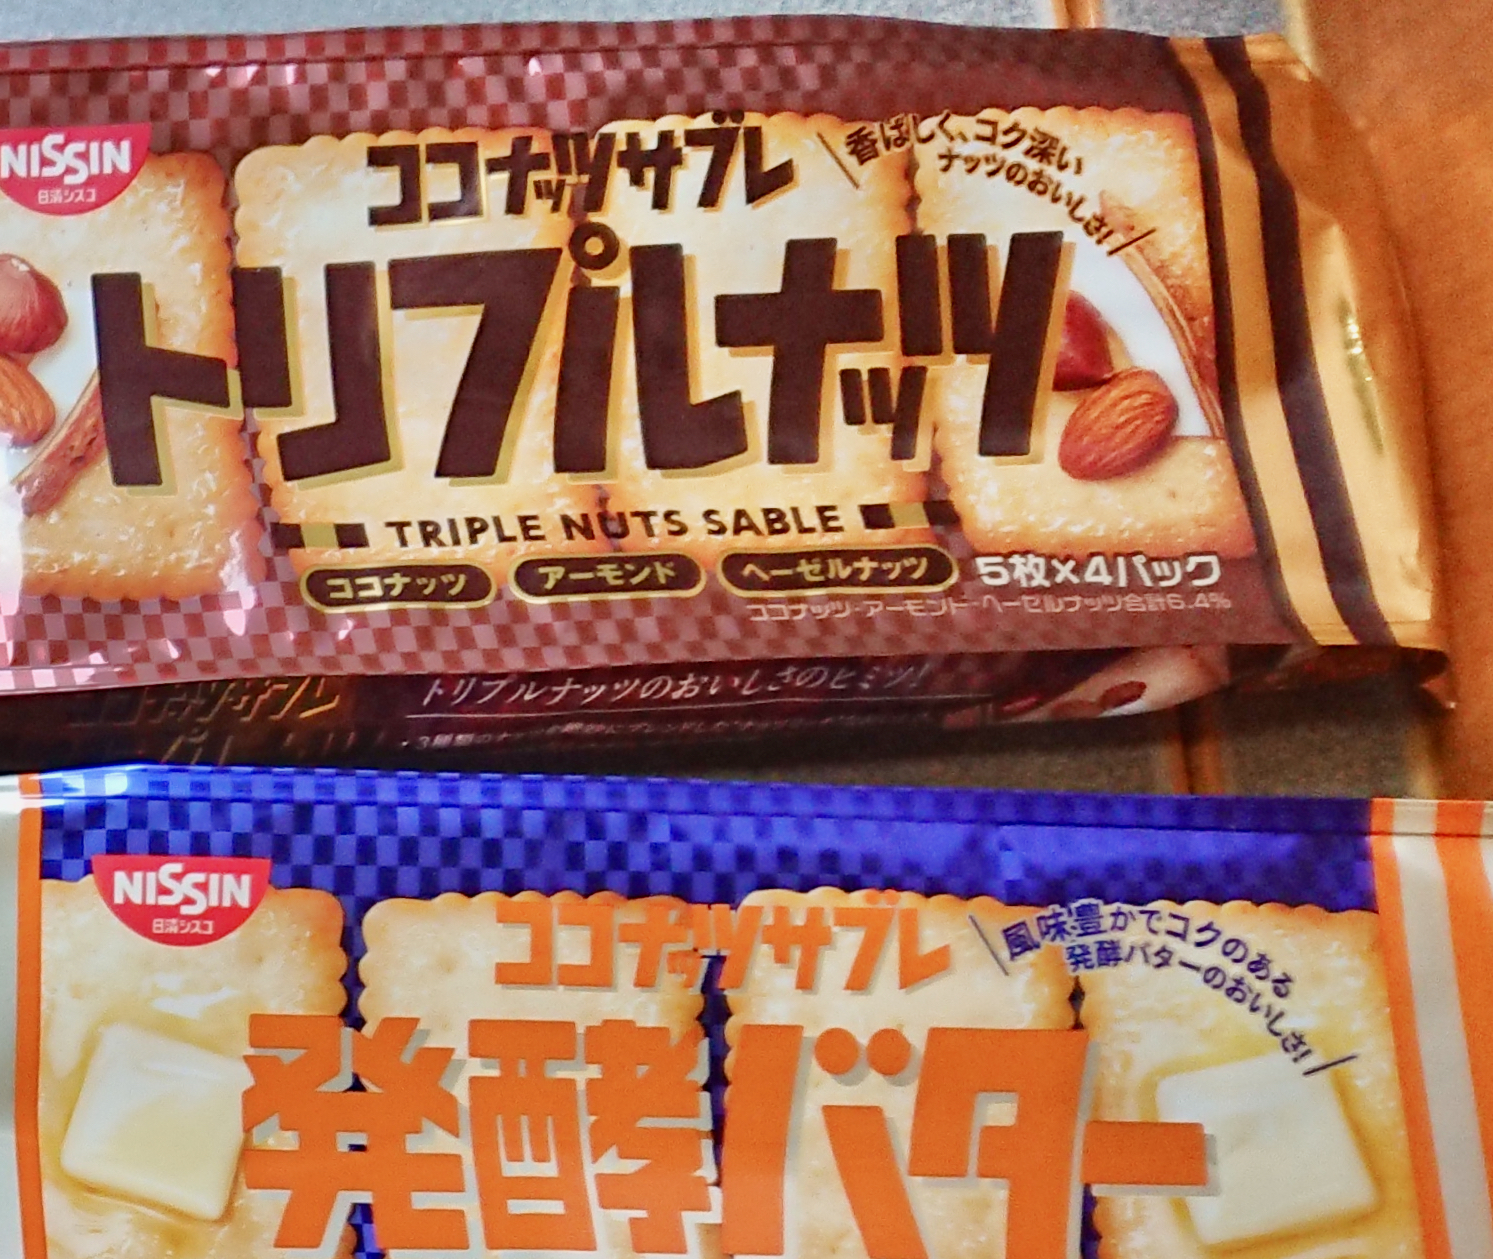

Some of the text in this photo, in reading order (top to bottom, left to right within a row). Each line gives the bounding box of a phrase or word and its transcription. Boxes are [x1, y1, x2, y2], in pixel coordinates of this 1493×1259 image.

[367, 109, 795, 227] ココナッツサブレ
[37, 187, 97, 205] 日清シスコ
[92, 221, 1065, 490] トリプルナッツ
[386, 503, 845, 549] TRIPLE NUTS SABLE
[326, 569, 468, 601] ココナッツ
[537, 561, 678, 587] アーモンド
[741, 556, 930, 583] ヘーゼルナッツ
[975, 554, 1221, 589] 5枚×4パック
[112, 861, 253, 917] NISSIN
[151, 917, 215, 937] 日清シスコ
[495, 891, 952, 994] ココナッツサブレ
[1001, 904, 1295, 999] 風味豊かでコクのある
